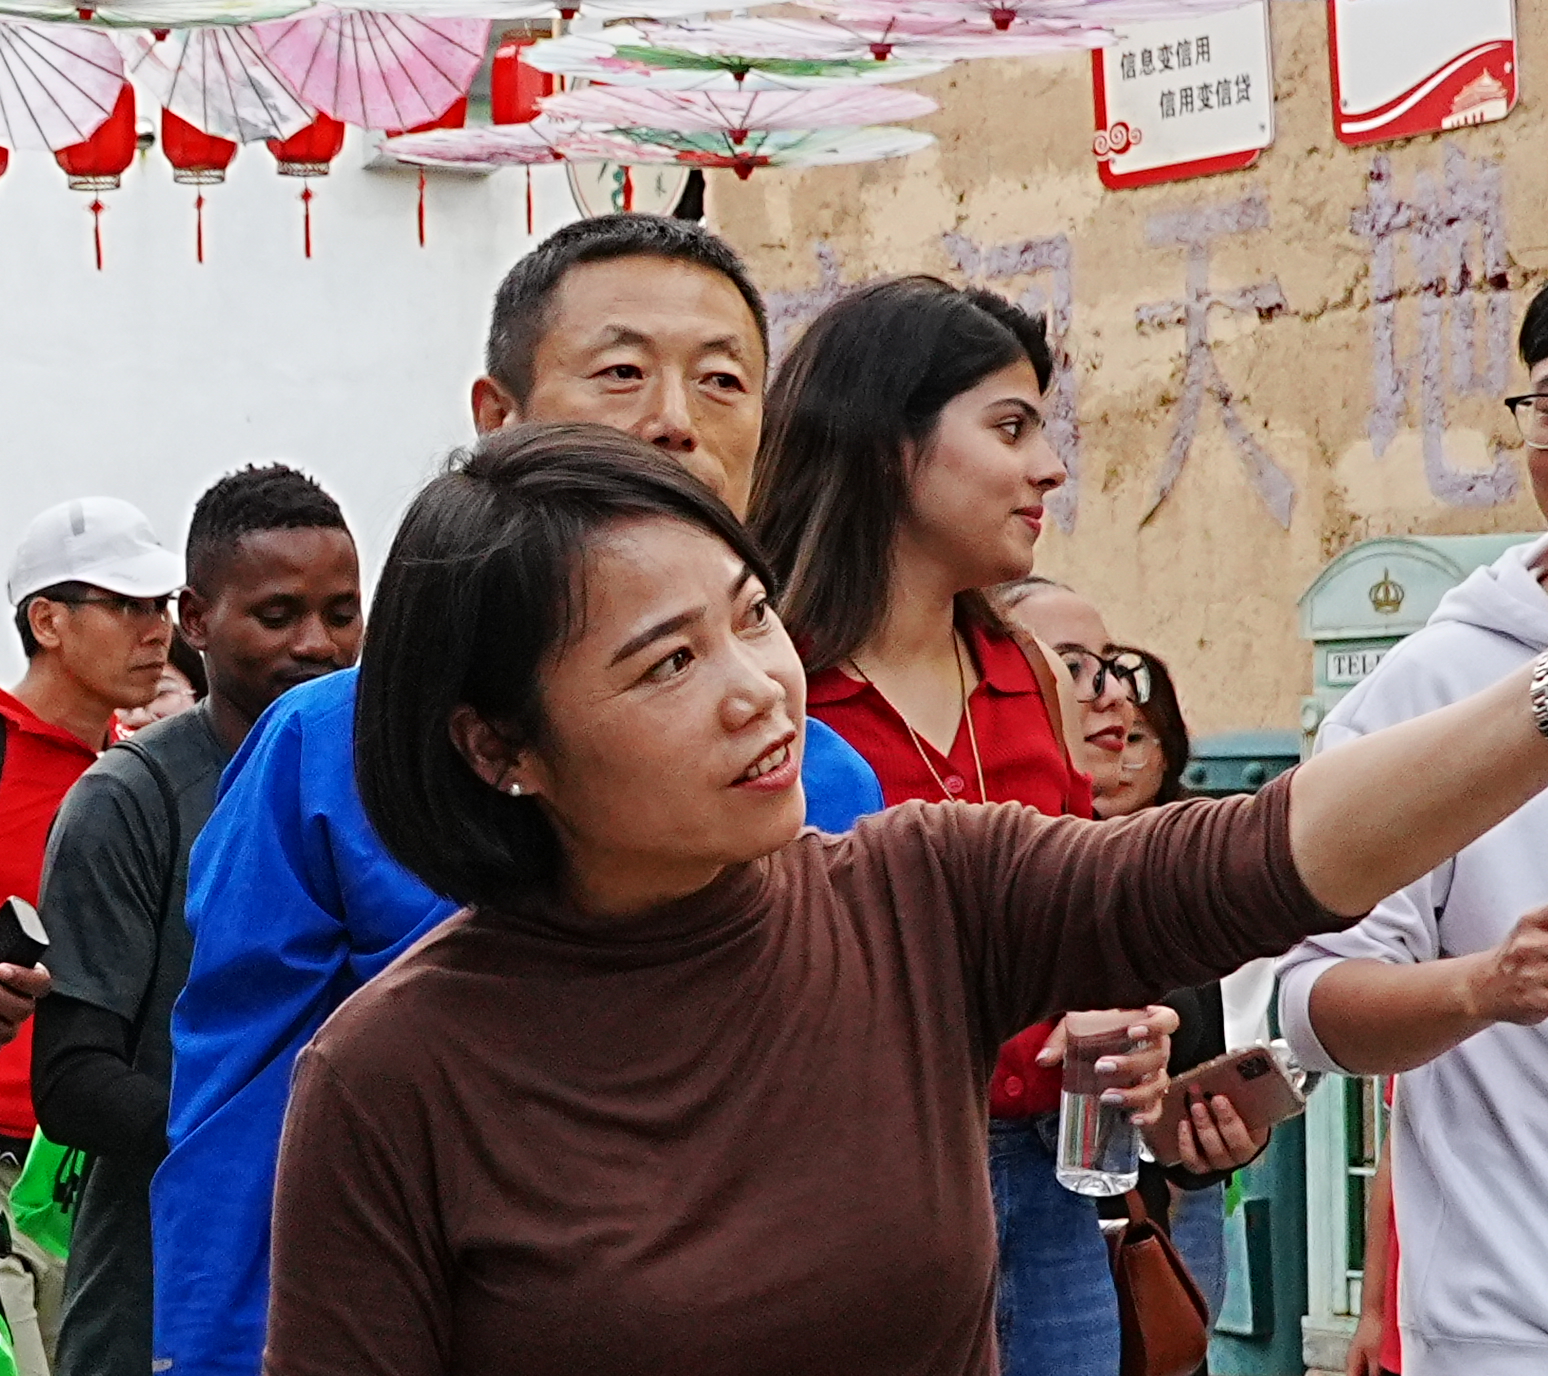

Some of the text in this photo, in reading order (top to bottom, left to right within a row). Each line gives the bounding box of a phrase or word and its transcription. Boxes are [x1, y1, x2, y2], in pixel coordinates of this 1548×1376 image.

[1120, 35, 1211, 81] 信息变信用
[1159, 72, 1252, 121] 信用变信贷
